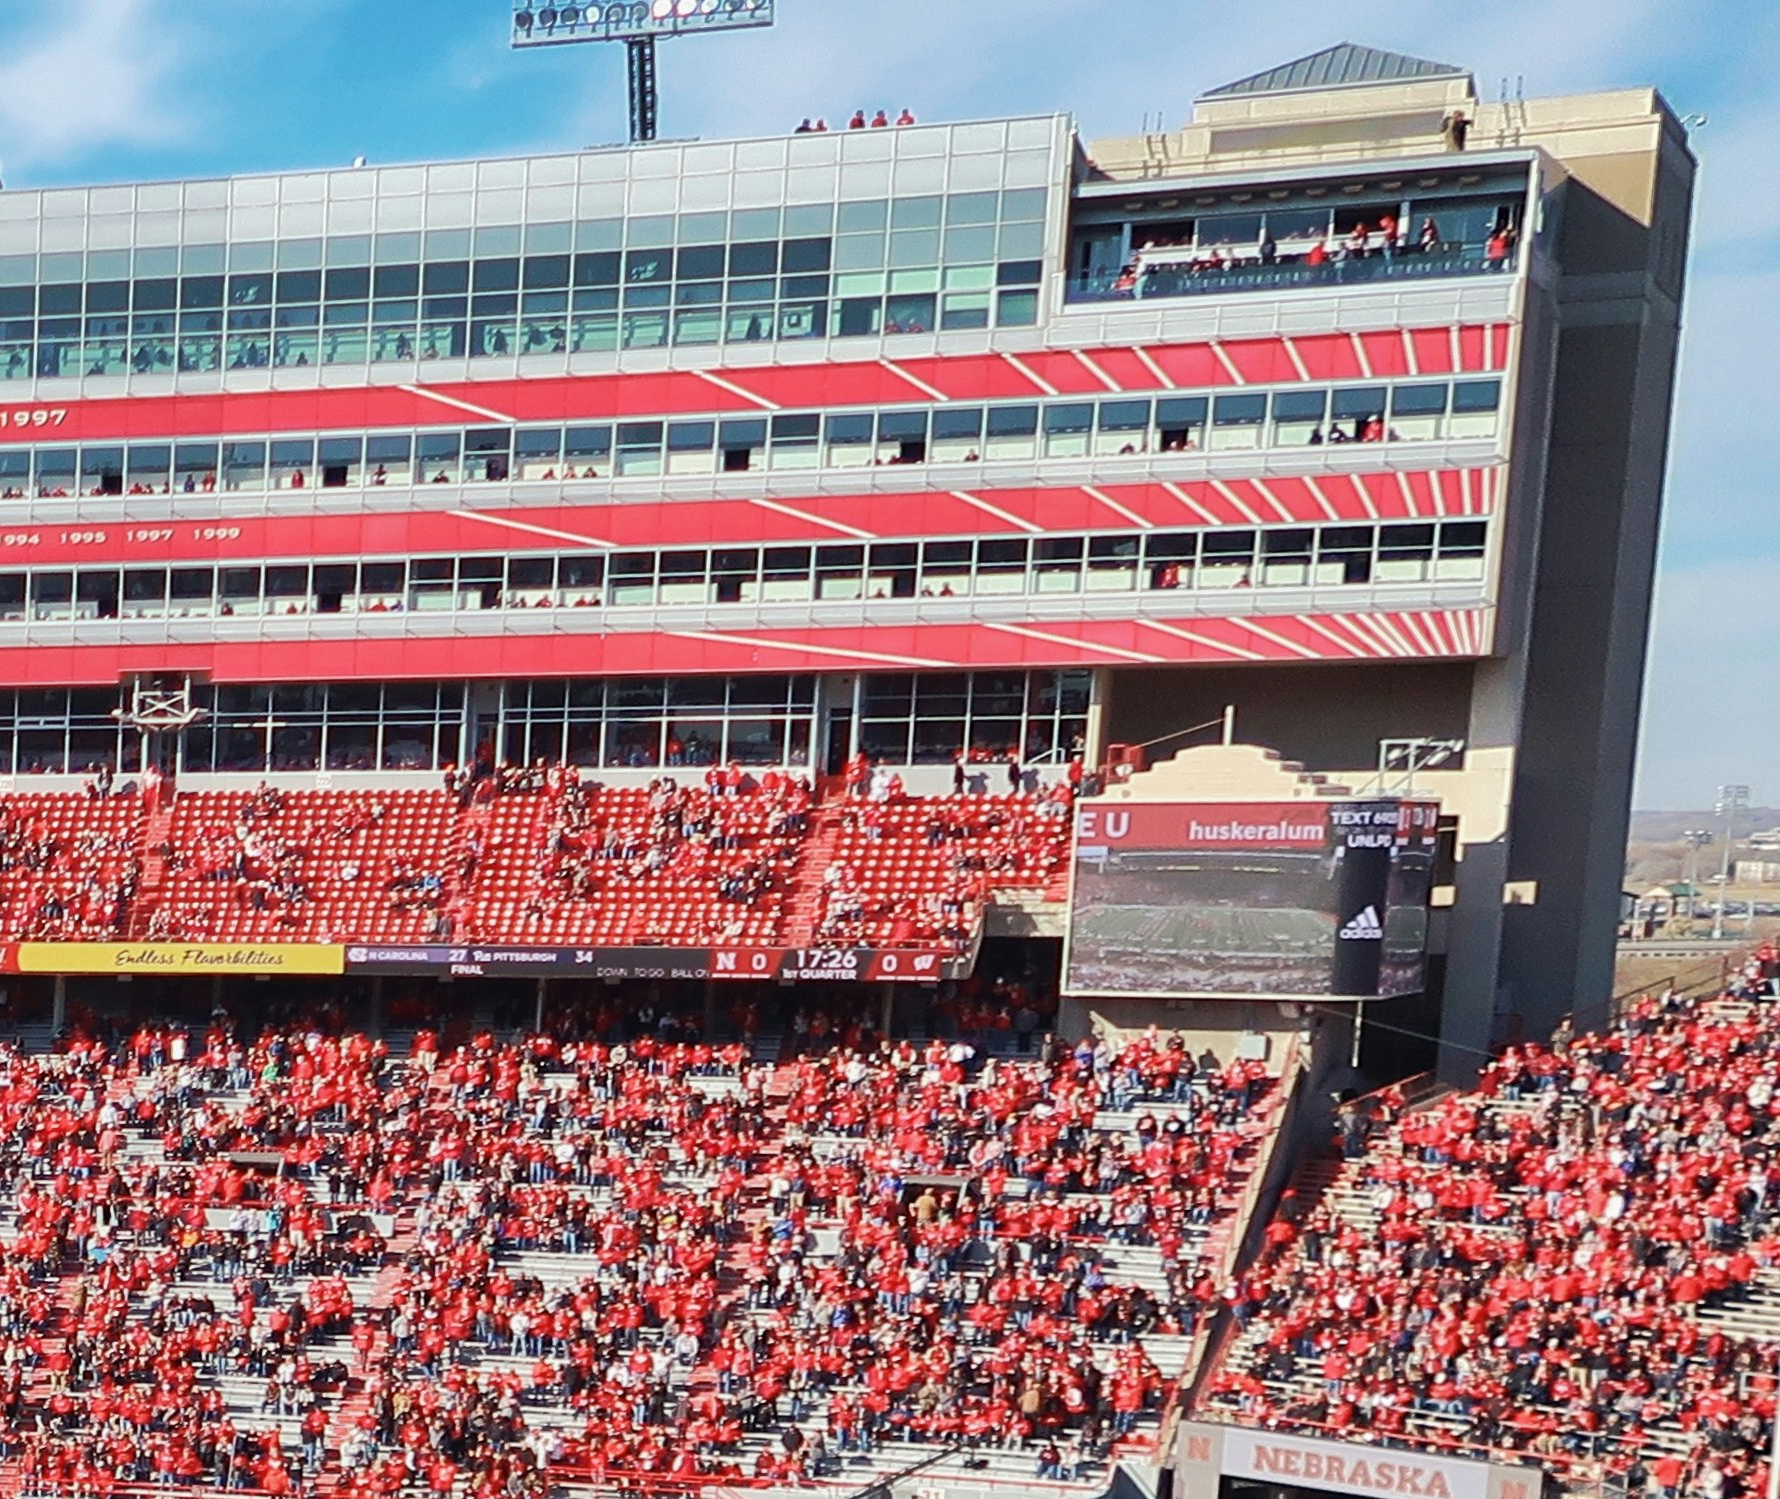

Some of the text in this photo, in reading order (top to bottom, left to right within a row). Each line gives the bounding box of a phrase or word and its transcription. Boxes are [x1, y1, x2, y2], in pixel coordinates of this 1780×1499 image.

[0, 408, 67, 428] 1997
[1106, 811, 1131, 838] U
[1188, 820, 1325, 841] huskeralum
[1330, 811, 1372, 825] TEXT
[115, 948, 283, 967] Endless Flavorbilities
[449, 949, 468, 962] 27
[493, 953, 557, 963] PITTSBURGH
[716, 952, 737, 972] N
[751, 953, 767, 971] 0
[796, 949, 857, 969] 17:26
[881, 954, 897, 972] 0
[451, 964, 484, 975] FINAL
[798, 969, 857, 980] QUARTER
[1187, 1435, 1212, 1462] N
[1253, 1445, 1453, 1499] NEBRASKA
